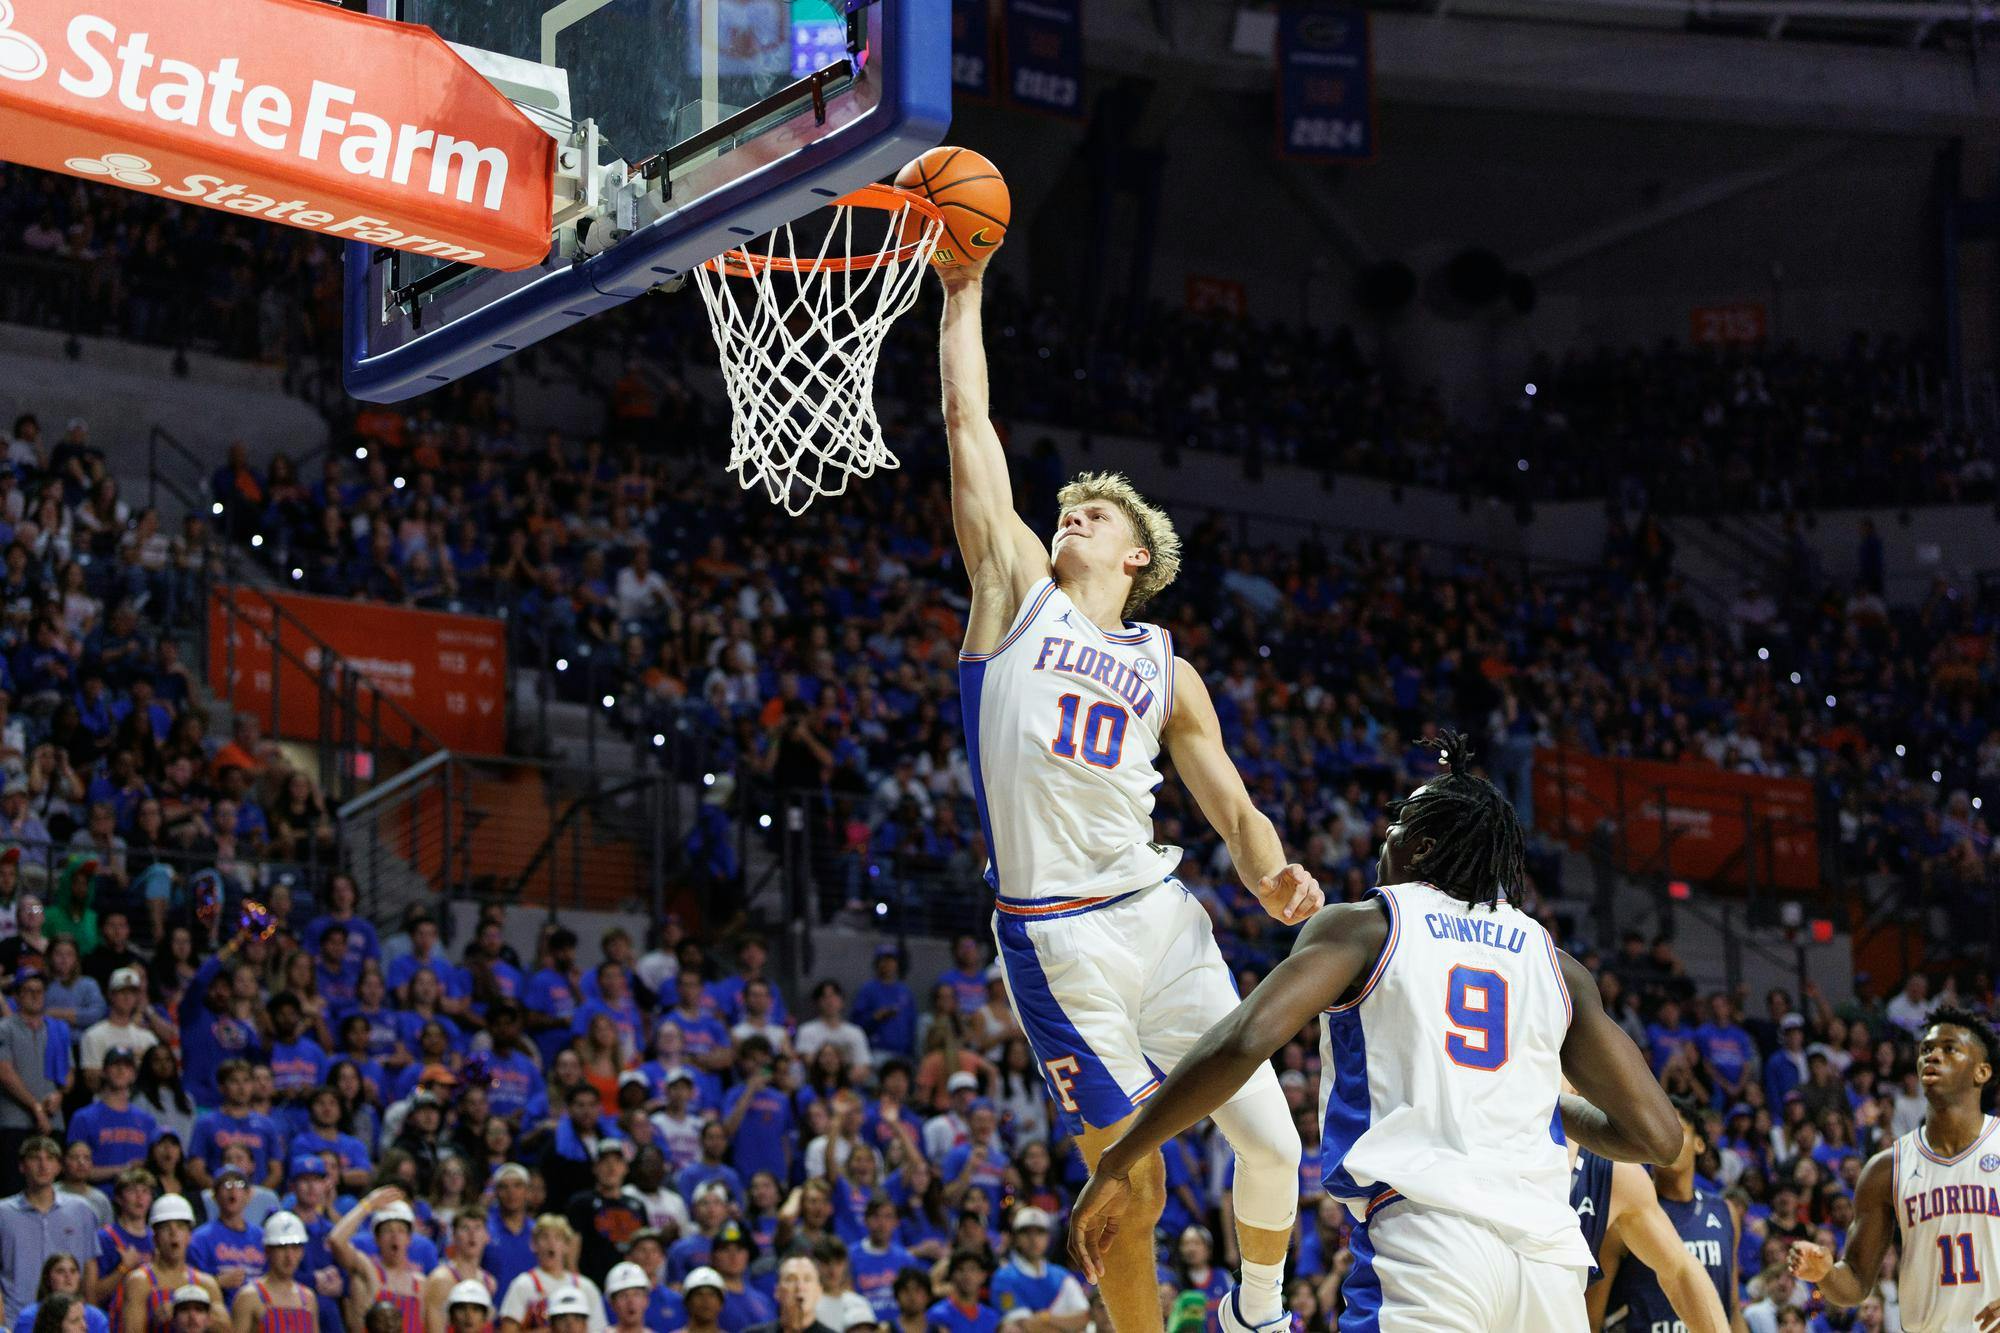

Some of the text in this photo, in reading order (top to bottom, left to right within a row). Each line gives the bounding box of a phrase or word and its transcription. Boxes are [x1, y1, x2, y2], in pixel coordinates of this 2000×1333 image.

[1015, 67, 1077, 107] 2023
[1289, 117, 1364, 149] 2024
[1032, 637, 1154, 720] FLORIDA
[1135, 659, 1157, 681] SEC
[1051, 693, 1130, 772] 10
[1425, 912, 1527, 954] CHINYELU
[1445, 963, 1509, 1072] 9
[1045, 1054, 1081, 1113] F
[1904, 1184, 2000, 1229] FLORIDA
[1936, 1232, 1981, 1286] 11
